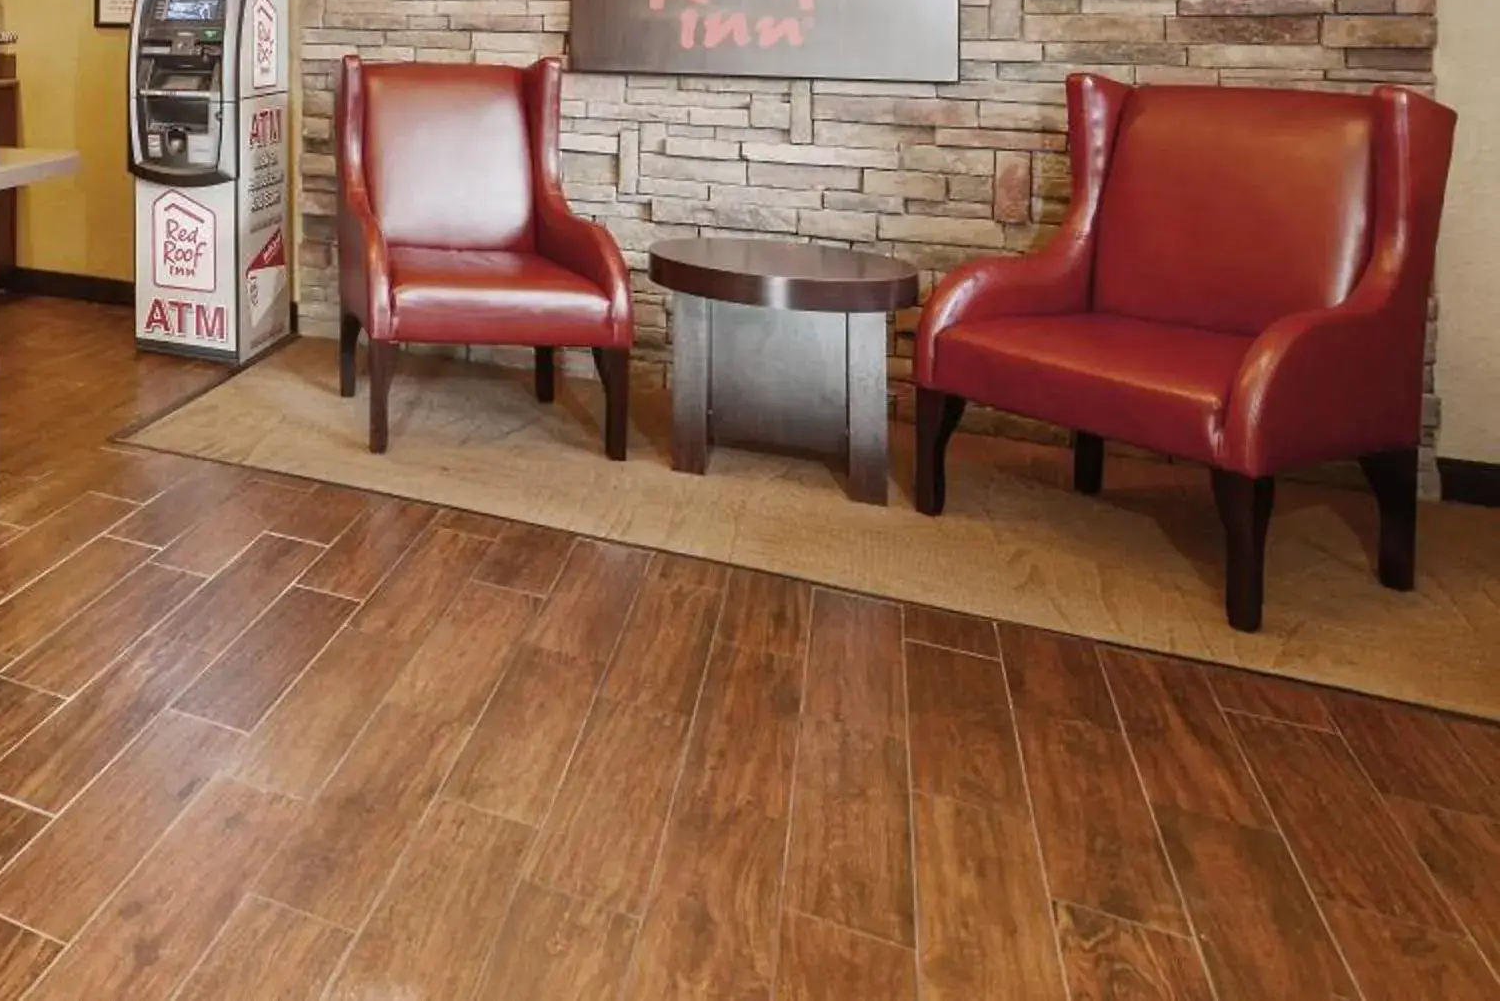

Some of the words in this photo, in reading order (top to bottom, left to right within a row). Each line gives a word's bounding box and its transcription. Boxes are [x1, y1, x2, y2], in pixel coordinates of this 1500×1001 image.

[165, 218, 199, 244] Red
[162, 241, 208, 269] Roof
[144, 297, 227, 343] ATM
